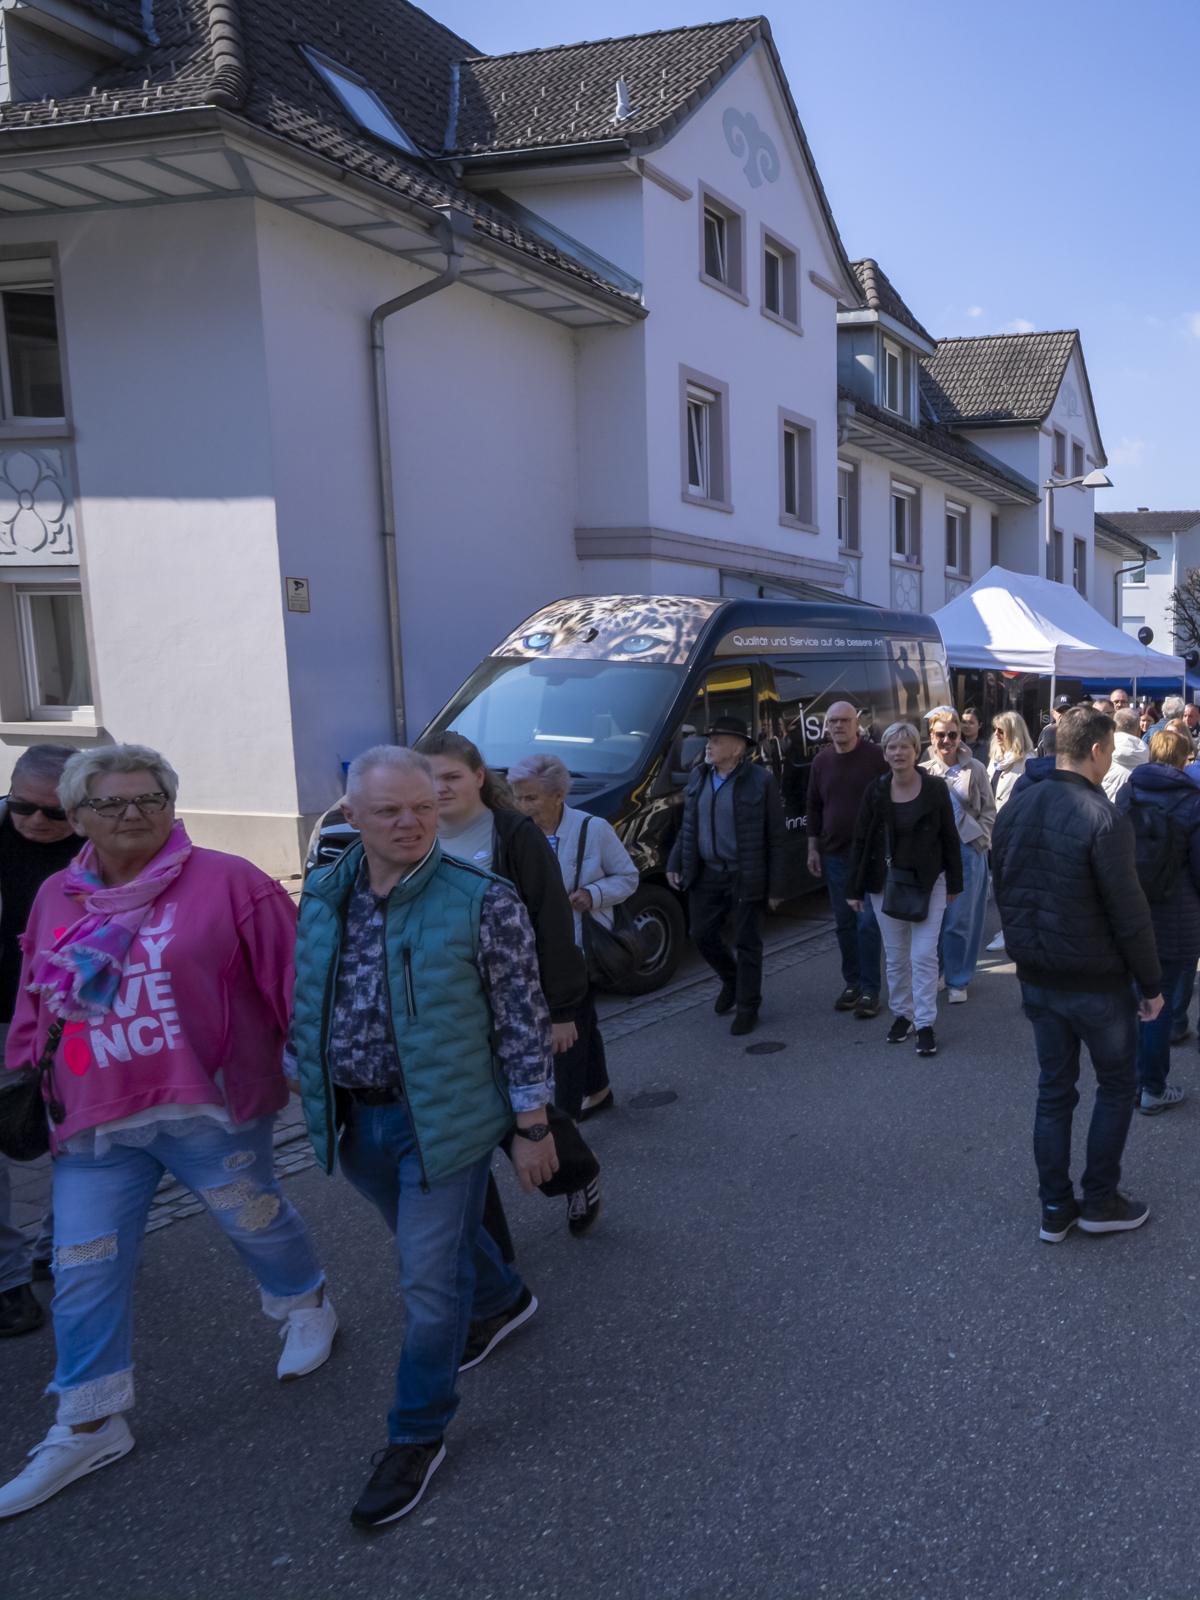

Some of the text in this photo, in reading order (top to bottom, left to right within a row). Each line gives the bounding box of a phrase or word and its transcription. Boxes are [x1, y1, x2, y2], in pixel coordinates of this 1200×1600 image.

[733, 635, 884, 647] Qualität und Service auf die bessere Art
[122, 933, 176, 977] LY
[63, 1010, 186, 1077] ONCE
